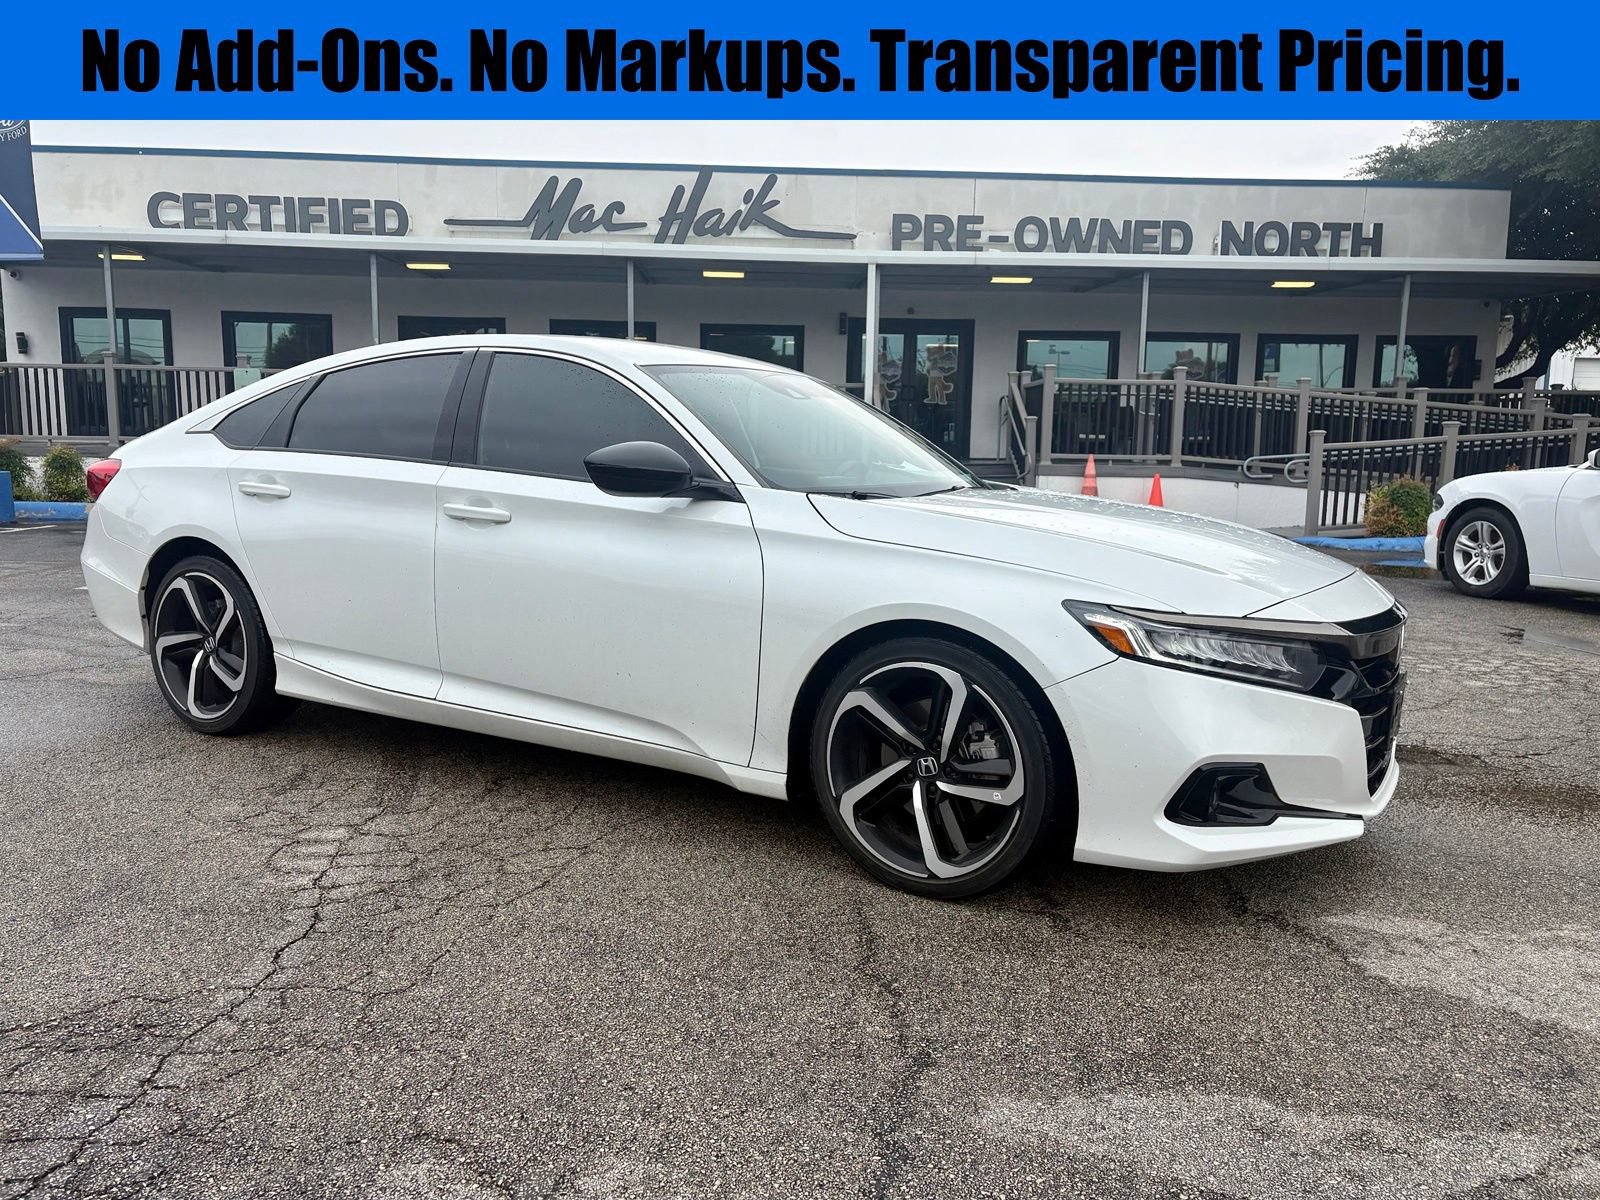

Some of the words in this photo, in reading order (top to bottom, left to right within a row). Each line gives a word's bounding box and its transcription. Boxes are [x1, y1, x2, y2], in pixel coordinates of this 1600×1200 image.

[7, 126, 27, 140] FORD
[147, 191, 409, 237] CERTIFIED
[443, 175, 647, 241] Mac
[654, 167, 857, 244] Haik
[891, 213, 1193, 256] PRE-OWNED
[1220, 220, 1384, 258] NORTH
